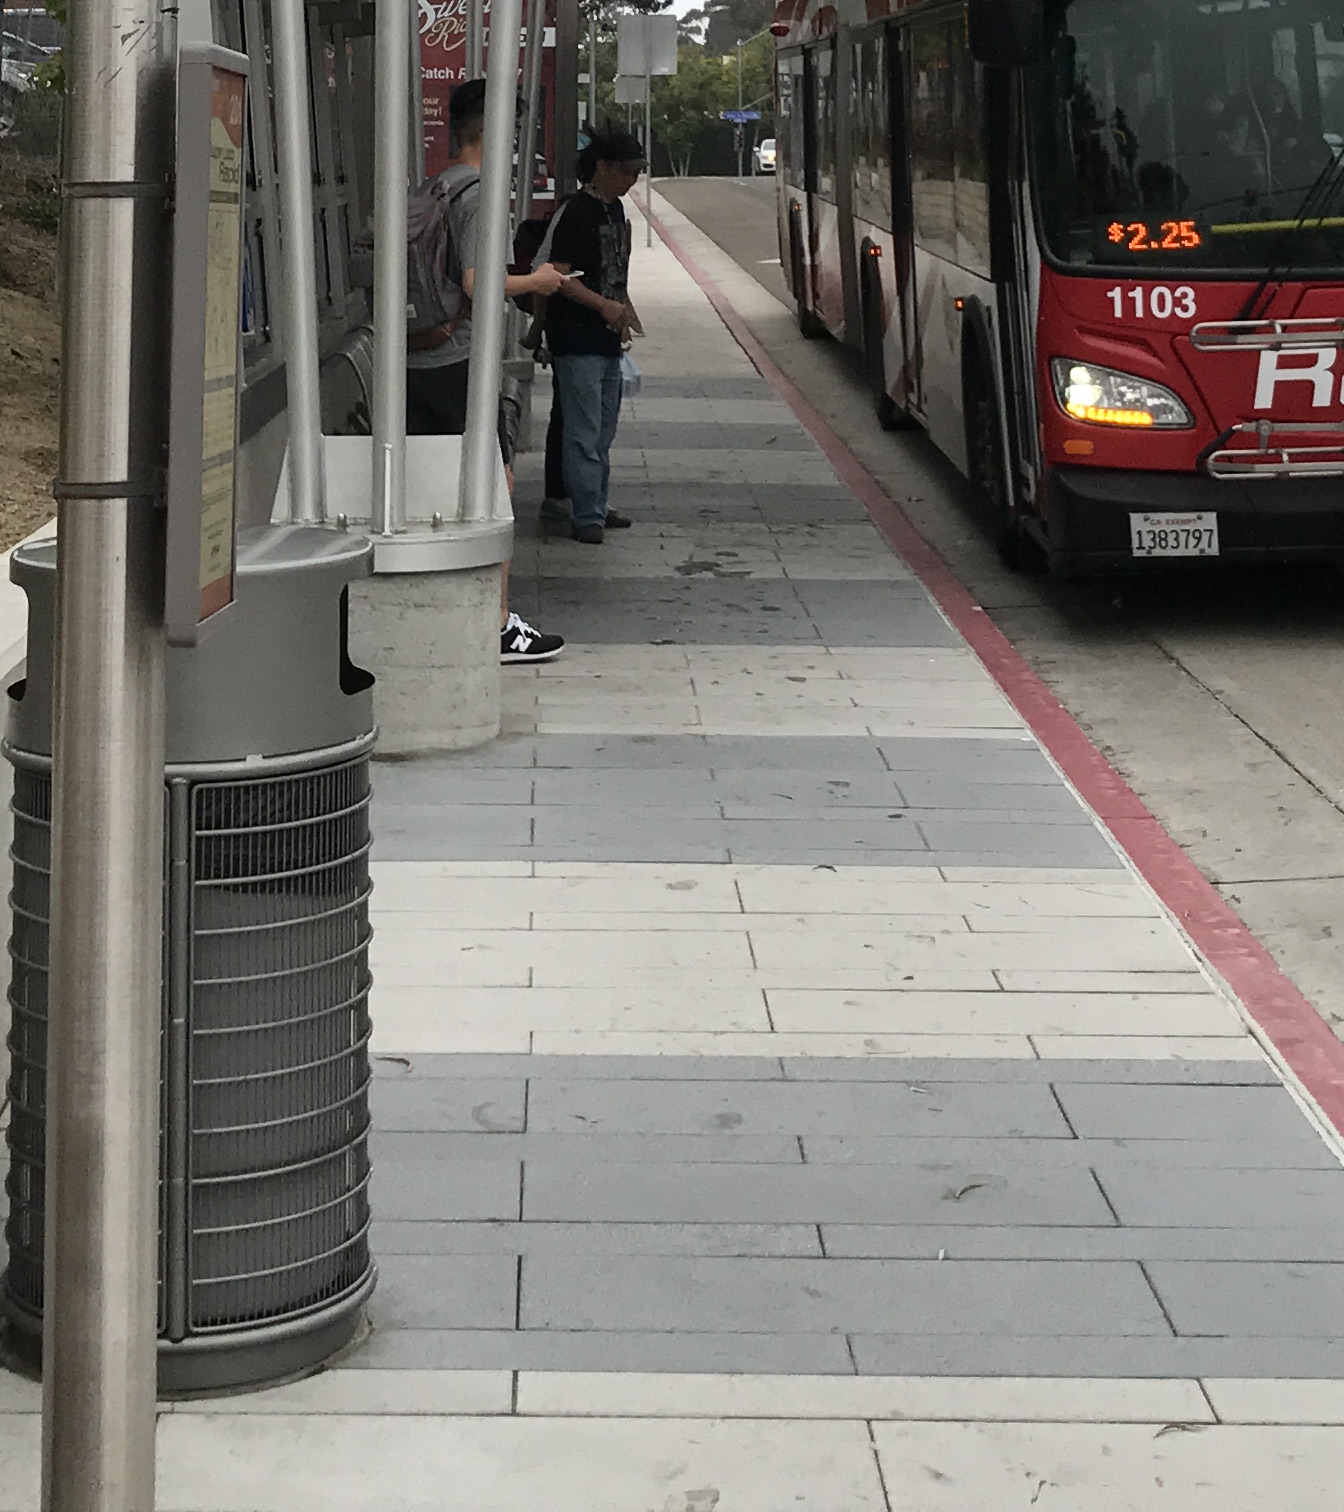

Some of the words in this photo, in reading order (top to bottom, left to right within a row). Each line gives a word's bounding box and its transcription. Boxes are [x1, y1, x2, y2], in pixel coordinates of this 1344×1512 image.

[1107, 220, 1201, 250] $2.25
[1107, 286, 1197, 319] 1103
[1135, 528, 1214, 550] 1383797
